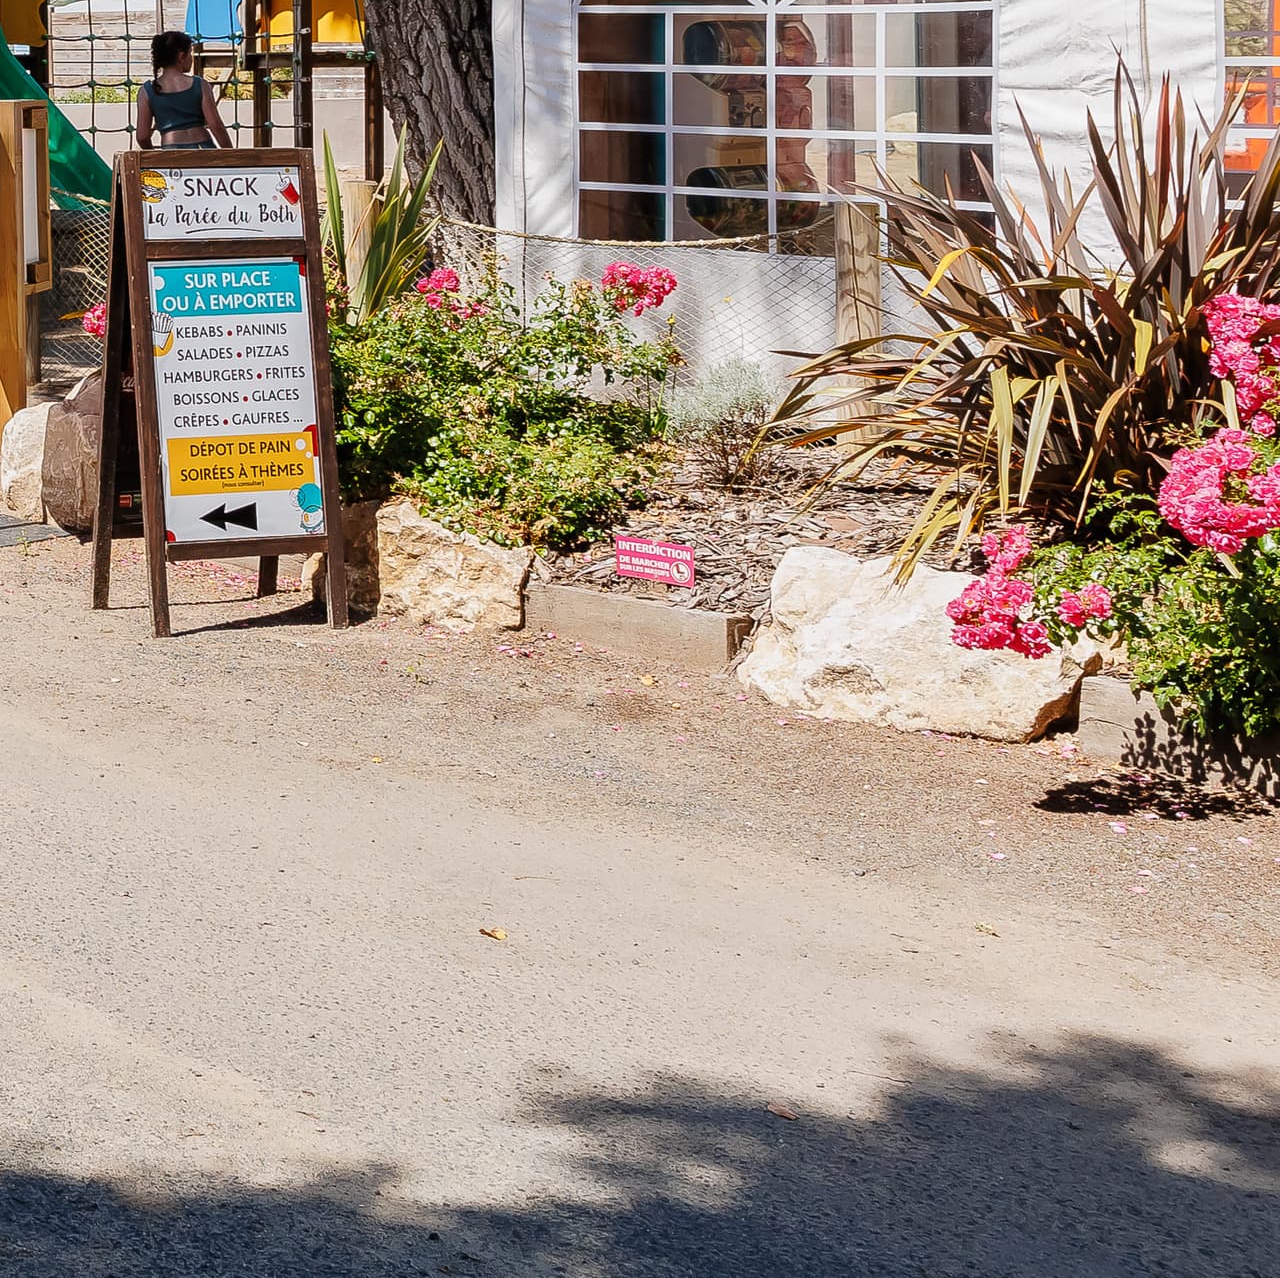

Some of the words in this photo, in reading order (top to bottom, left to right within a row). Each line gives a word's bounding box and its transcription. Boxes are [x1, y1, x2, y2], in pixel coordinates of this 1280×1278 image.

[184, 178, 259, 197] SNACK
[148, 204, 168, 226] La
[175, 204, 221, 224] Parée
[229, 205, 251, 224] du
[258, 203, 297, 223] Both
[185, 273, 218, 289] SUR
[221, 271, 271, 288] PLACE
[162, 296, 188, 312] OU
[194, 291, 206, 311] À
[210, 292, 296, 310] EMPORTER
[176, 325, 223, 339] KEBABS
[236, 323, 287, 336] PANINIS
[177, 348, 232, 361] SALADES
[245, 345, 289, 358] PIZZAS
[164, 369, 253, 384] HAMBURGERS
[265, 366, 305, 379] FRITES
[173, 391, 239, 406] BOISSONS
[252, 389, 299, 402] GLACES
[174, 413, 219, 428] CRÊPES
[232, 411, 289, 426] GAUFRES
[190, 441, 234, 457] DÉPOT
[239, 442, 256, 454] DE
[260, 440, 290, 454] PAIN
[181, 464, 234, 482] SOIRÉES
[238, 463, 248, 478] À
[250, 462, 304, 477] THÈMES
[618, 540, 691, 561] INTERDICTION
[619, 555, 630, 563] DE
[632, 556, 670, 570] MARCHER
